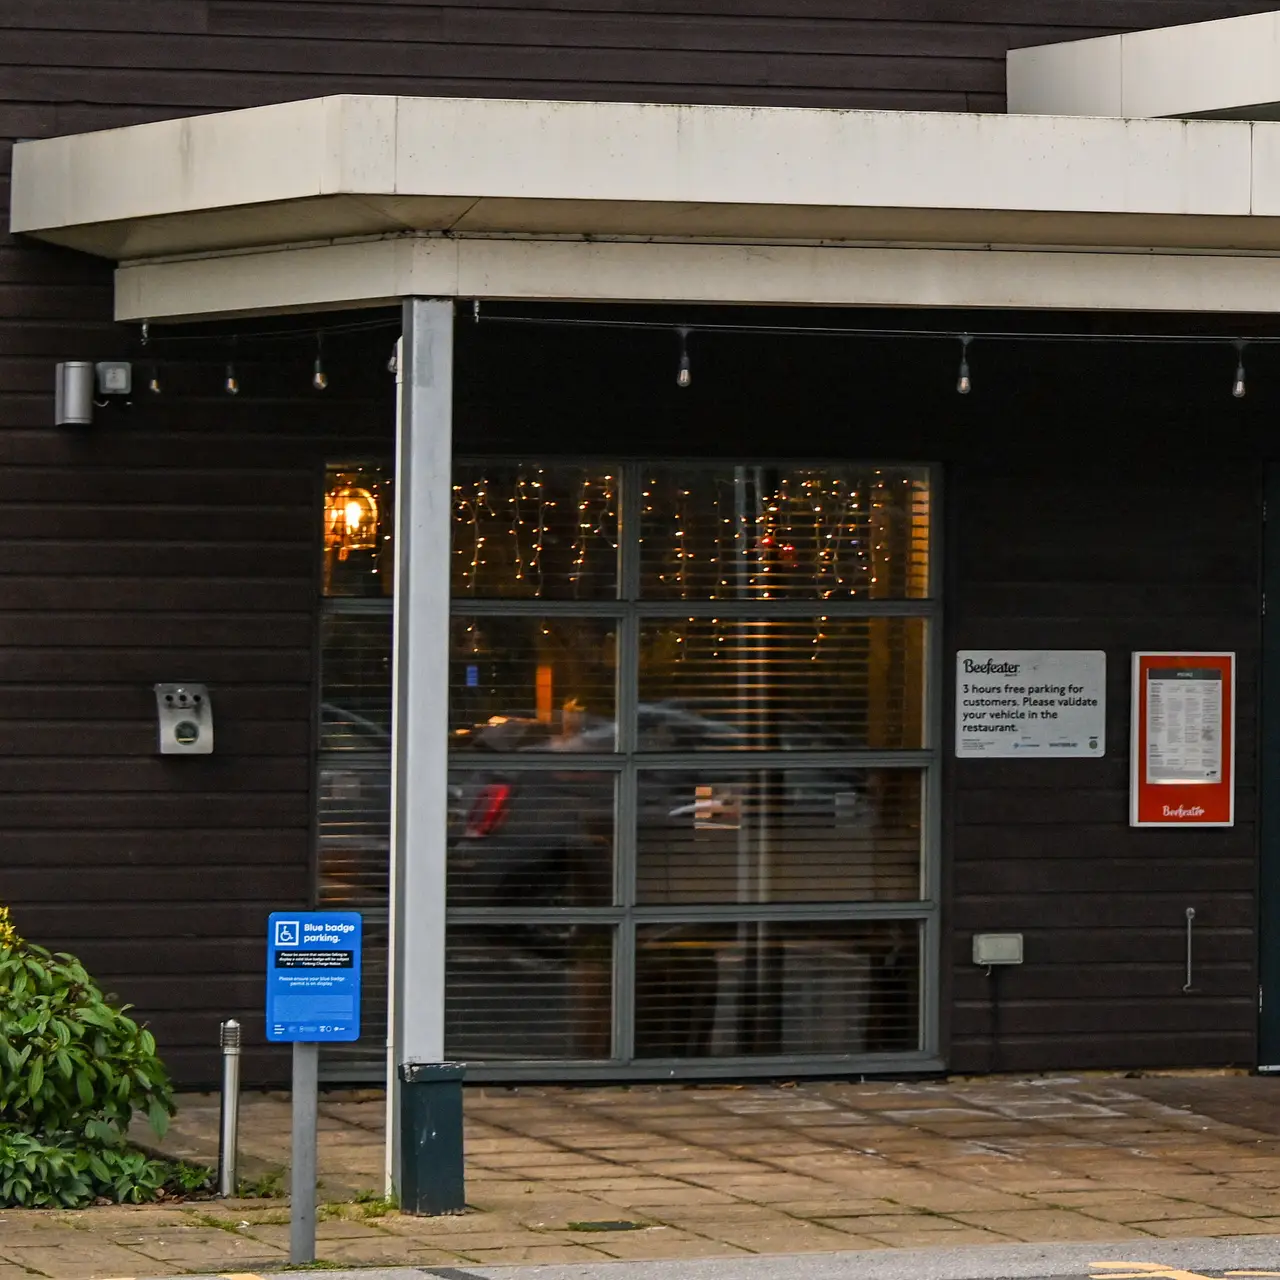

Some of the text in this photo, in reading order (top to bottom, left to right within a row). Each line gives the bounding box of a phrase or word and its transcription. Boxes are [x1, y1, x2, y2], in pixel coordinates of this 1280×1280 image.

[963, 658, 1020, 675] Beefeater
[963, 684, 1084, 696] 3 hours free parking for
[963, 697, 1098, 707] customers. Please validate
[963, 710, 1058, 721] your vehicle in the
[963, 724, 1019, 732] restaurant.
[1162, 804, 1205, 818] Beefeater
[304, 923, 355, 933] Blue badge
[304, 933, 341, 944] parking.
